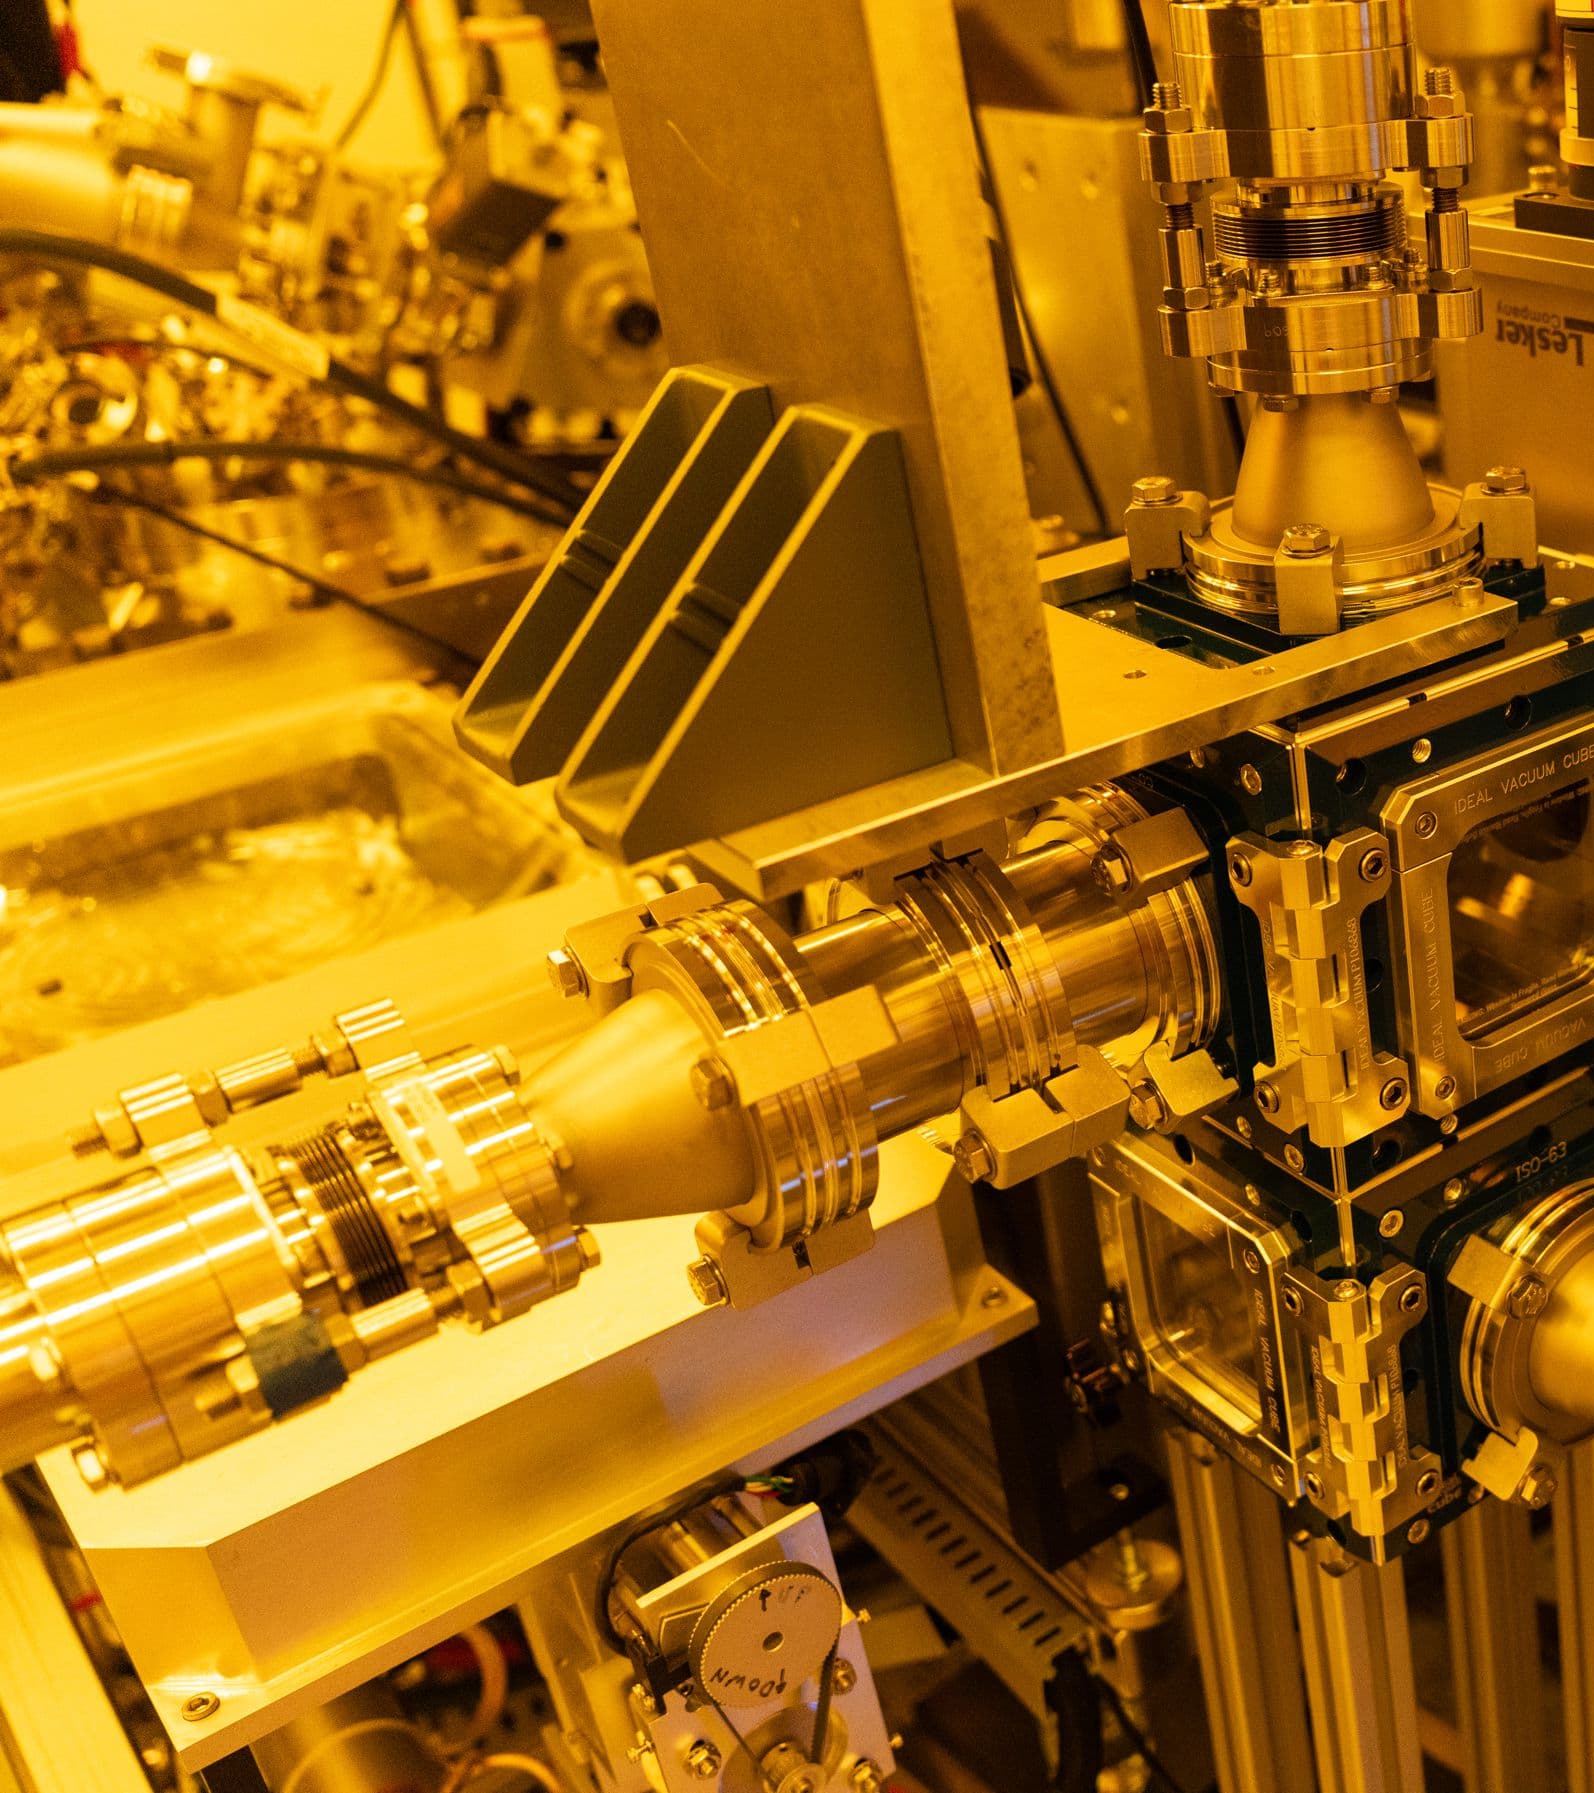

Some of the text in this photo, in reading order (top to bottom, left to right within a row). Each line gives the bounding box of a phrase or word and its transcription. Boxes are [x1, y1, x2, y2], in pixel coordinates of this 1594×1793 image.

[1497, 302, 1561, 330] Company
[1496, 318, 1584, 367] Lesker
[1454, 788, 1493, 814] IDEAL
[1500, 761, 1556, 795] VACUUM
[1420, 888, 1446, 1061] IDEAL VACUUM CUBE
[1535, 1017, 1586, 1056] VACUUM
[1495, 1047, 1528, 1073] CUBE
[1515, 1141, 1567, 1183] ISO-63
[1260, 1336, 1276, 1392] VACUUM
[709, 1667, 776, 1698] DOWN
